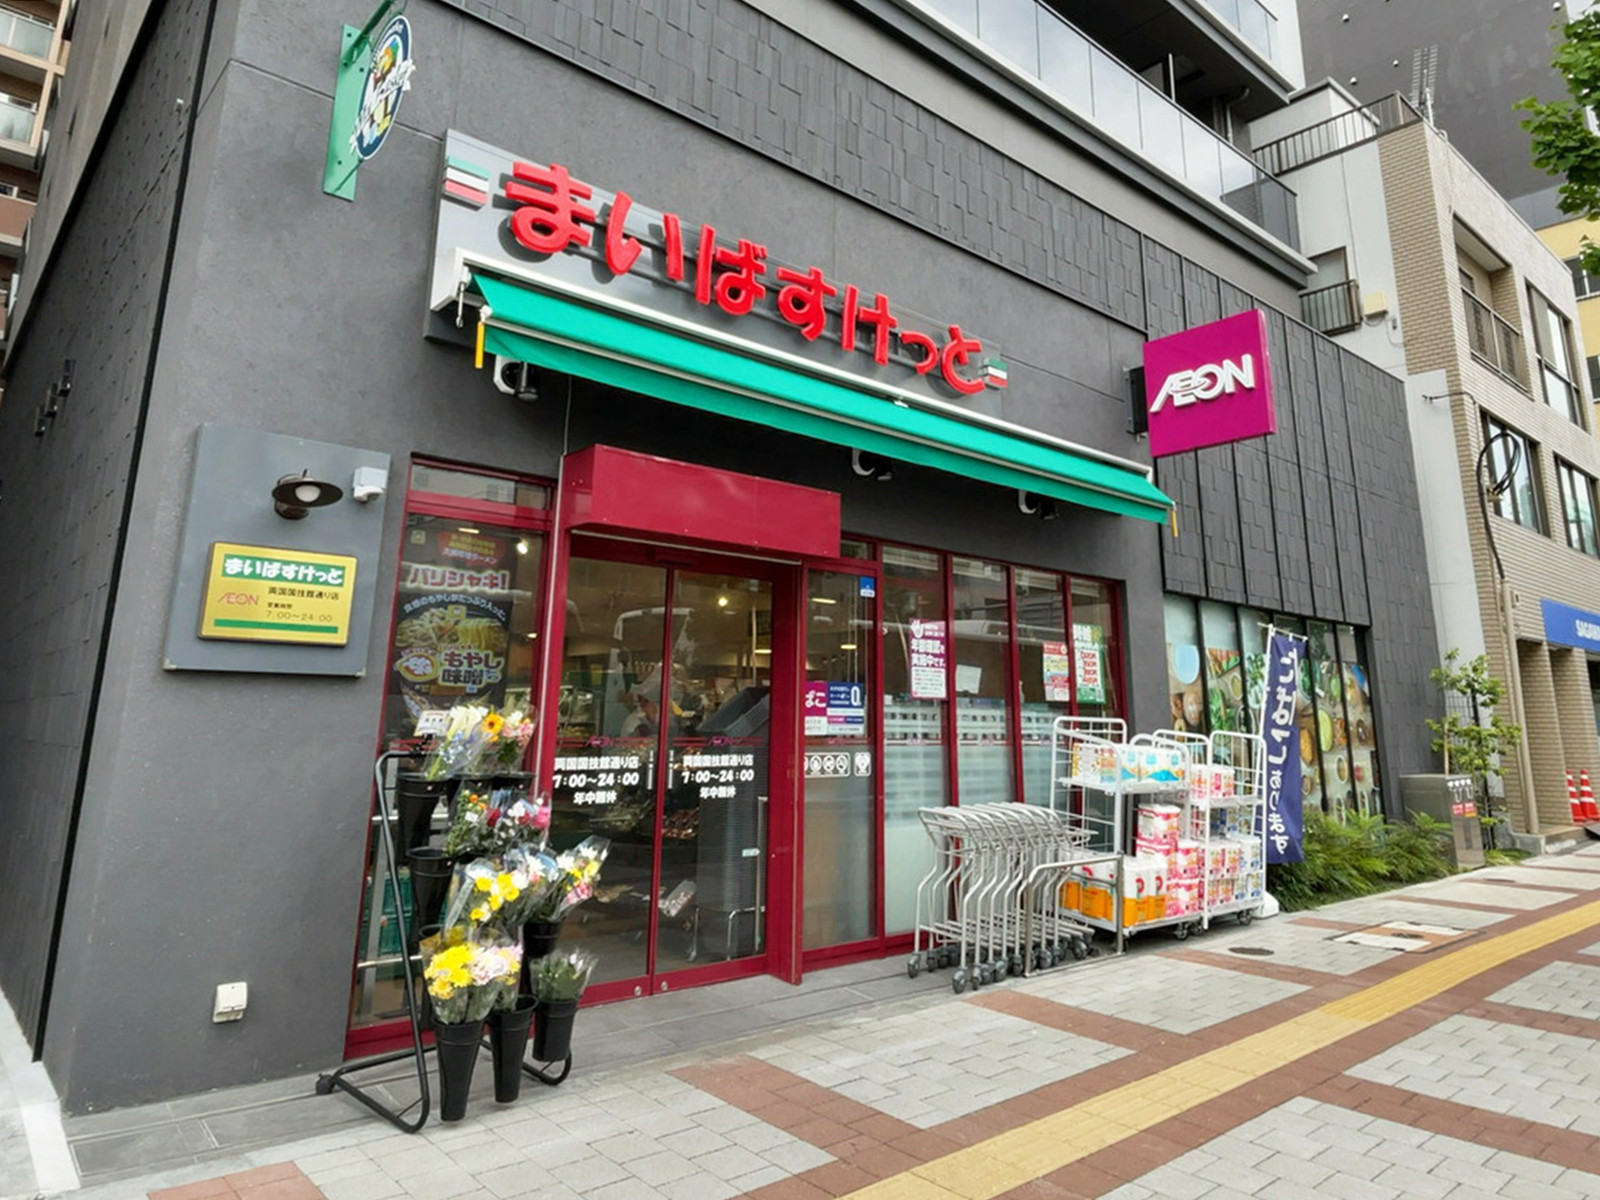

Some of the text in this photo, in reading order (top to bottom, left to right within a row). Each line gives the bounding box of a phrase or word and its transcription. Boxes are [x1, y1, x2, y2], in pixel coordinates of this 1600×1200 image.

[504, 162, 986, 395] まいばすけっと
[1149, 353, 1255, 413] AEON
[225, 557, 343, 584] まいばすけっと
[218, 591, 259, 606] AEON
[443, 651, 503, 669] もやし
